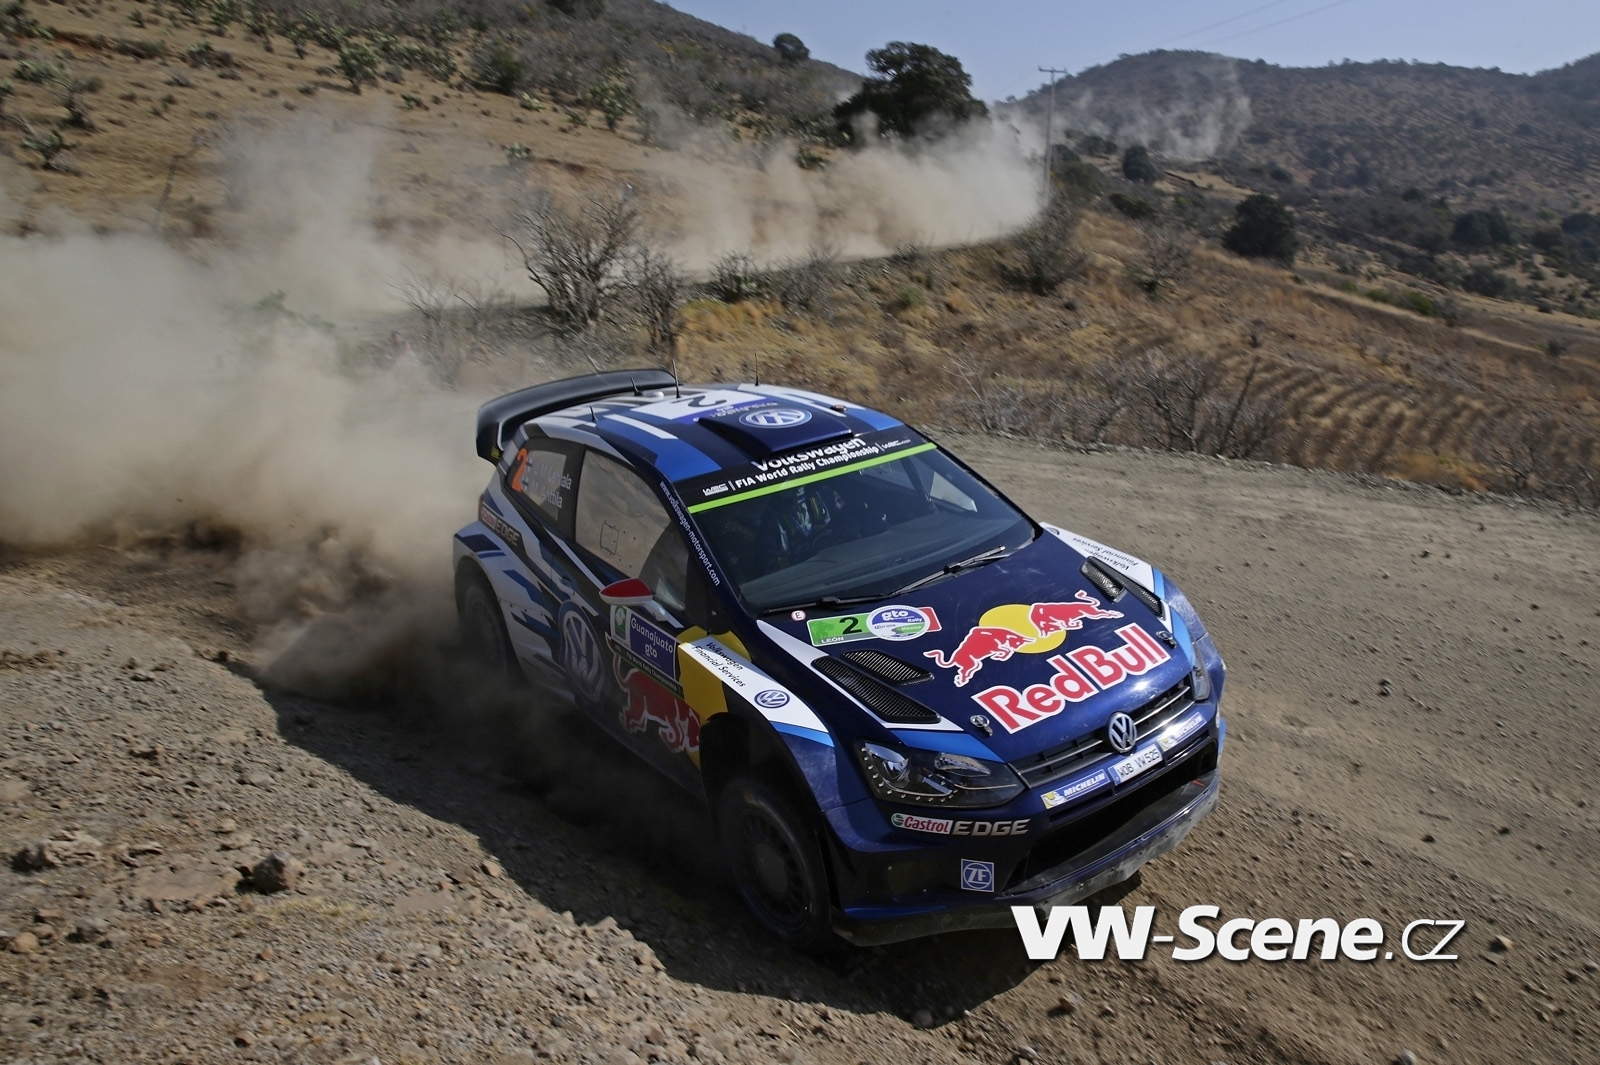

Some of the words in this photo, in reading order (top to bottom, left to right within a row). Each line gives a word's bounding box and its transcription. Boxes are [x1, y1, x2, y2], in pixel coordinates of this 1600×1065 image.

[511, 448, 528, 493] 2
[735, 477, 757, 490] FIA
[754, 468, 789, 483] World
[789, 459, 817, 475] Rally
[817, 445, 880, 468] Championship
[659, 480, 721, 587] www.volkswagen-motorsport.com
[839, 616, 863, 635] 2
[881, 609, 909, 622] gto
[630, 617, 674, 654] Guanajuato
[820, 636, 845, 644] LEÓN
[644, 642, 659, 659] gto
[706, 641, 744, 671] Volkswagen
[692, 645, 721, 668] Financial
[718, 664, 747, 688] Services
[1063, 772, 1107, 797] MICHELIN
[903, 816, 950, 833] Castrol
[952, 818, 1032, 837] EDGE
[964, 866, 991, 884] ZF
